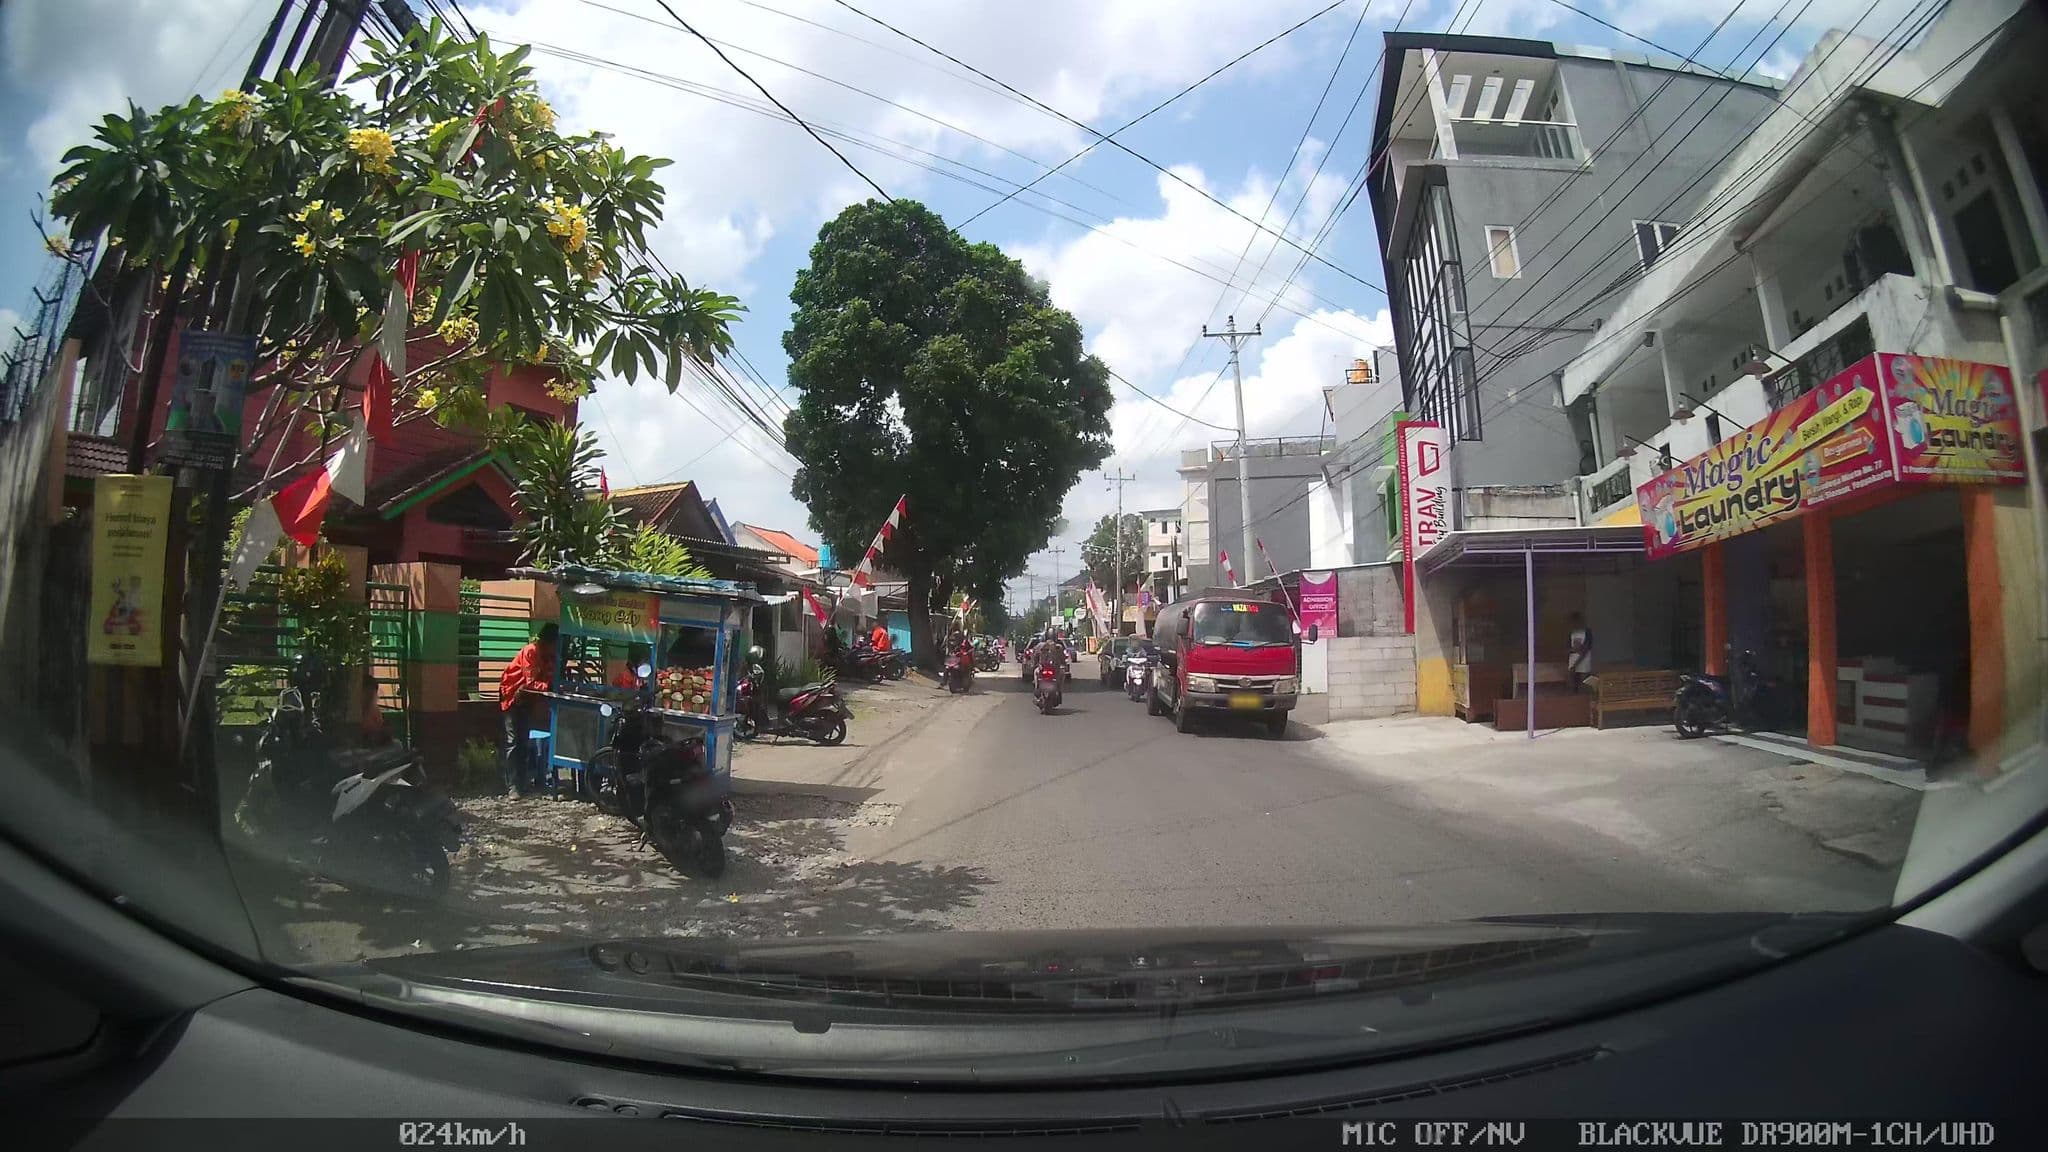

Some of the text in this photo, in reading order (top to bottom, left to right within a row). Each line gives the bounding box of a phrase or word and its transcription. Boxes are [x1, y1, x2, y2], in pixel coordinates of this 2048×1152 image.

[1684, 433, 1772, 497] Magic
[1431, 486, 1448, 528] Building
[1679, 467, 1802, 535] Laundry
